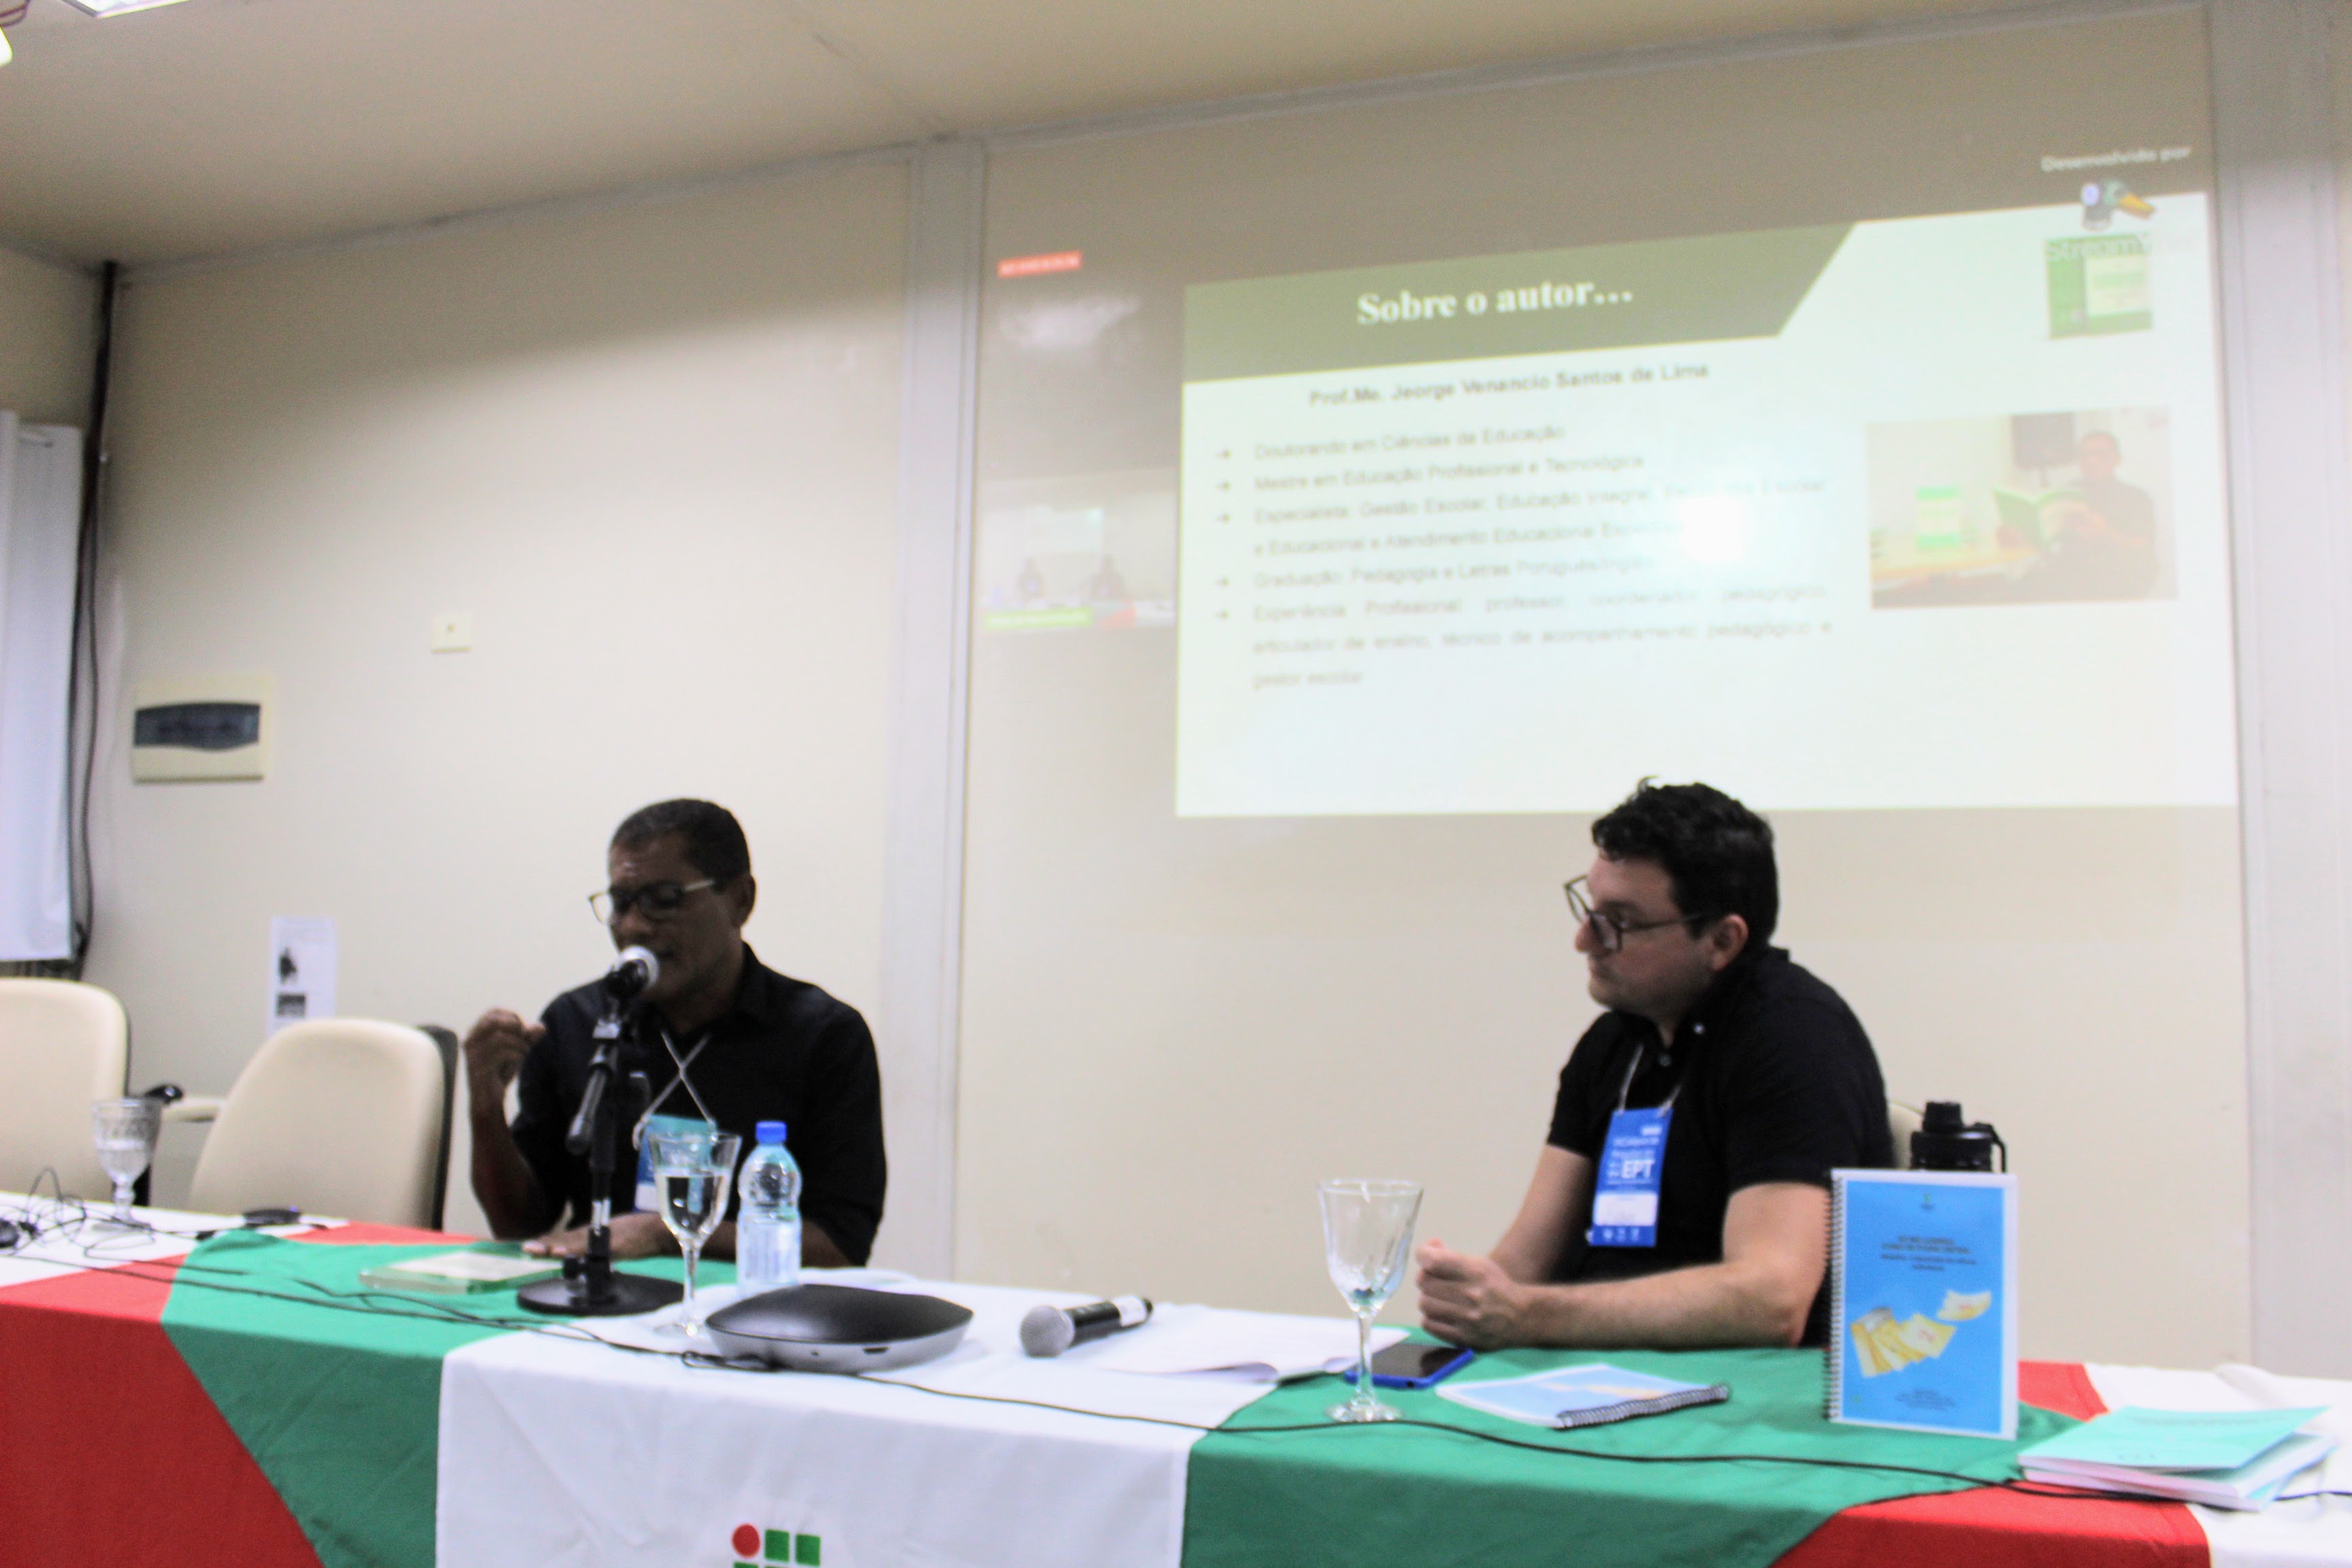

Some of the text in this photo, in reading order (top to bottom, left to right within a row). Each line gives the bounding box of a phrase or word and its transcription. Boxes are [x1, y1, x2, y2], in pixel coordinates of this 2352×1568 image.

[1356, 281, 1633, 325] Sobre o autor...
[1390, 382, 1455, 402] Jeorge
[1460, 374, 1550, 395] Venancio
[1556, 371, 1624, 389] Santos
[1631, 368, 1654, 385] de
[1661, 364, 1710, 382] Lima
[1352, 439, 1376, 454] em
[1382, 430, 1450, 451] Ciências
[1483, 423, 1565, 444] Educação
[1255, 453, 1644, 491] Mestre em Educação Profissional e Tecnológica
[1359, 498, 1419, 518] Gestão
[1496, 490, 1580, 510] Educação
[1254, 544, 1263, 557] e
[1370, 537, 1379, 549] e
[1386, 527, 1488, 549] Atendimento
[1351, 564, 1437, 585] Pedagogia
[1442, 565, 1452, 578] e
[1458, 561, 1509, 581] Letras
[1253, 602, 1346, 622] Experiência
[1344, 634, 1365, 651] de
[1510, 628, 1532, 645] de
[1820, 620, 1832, 634] e
[1621, 1158, 1656, 1180] EPT
